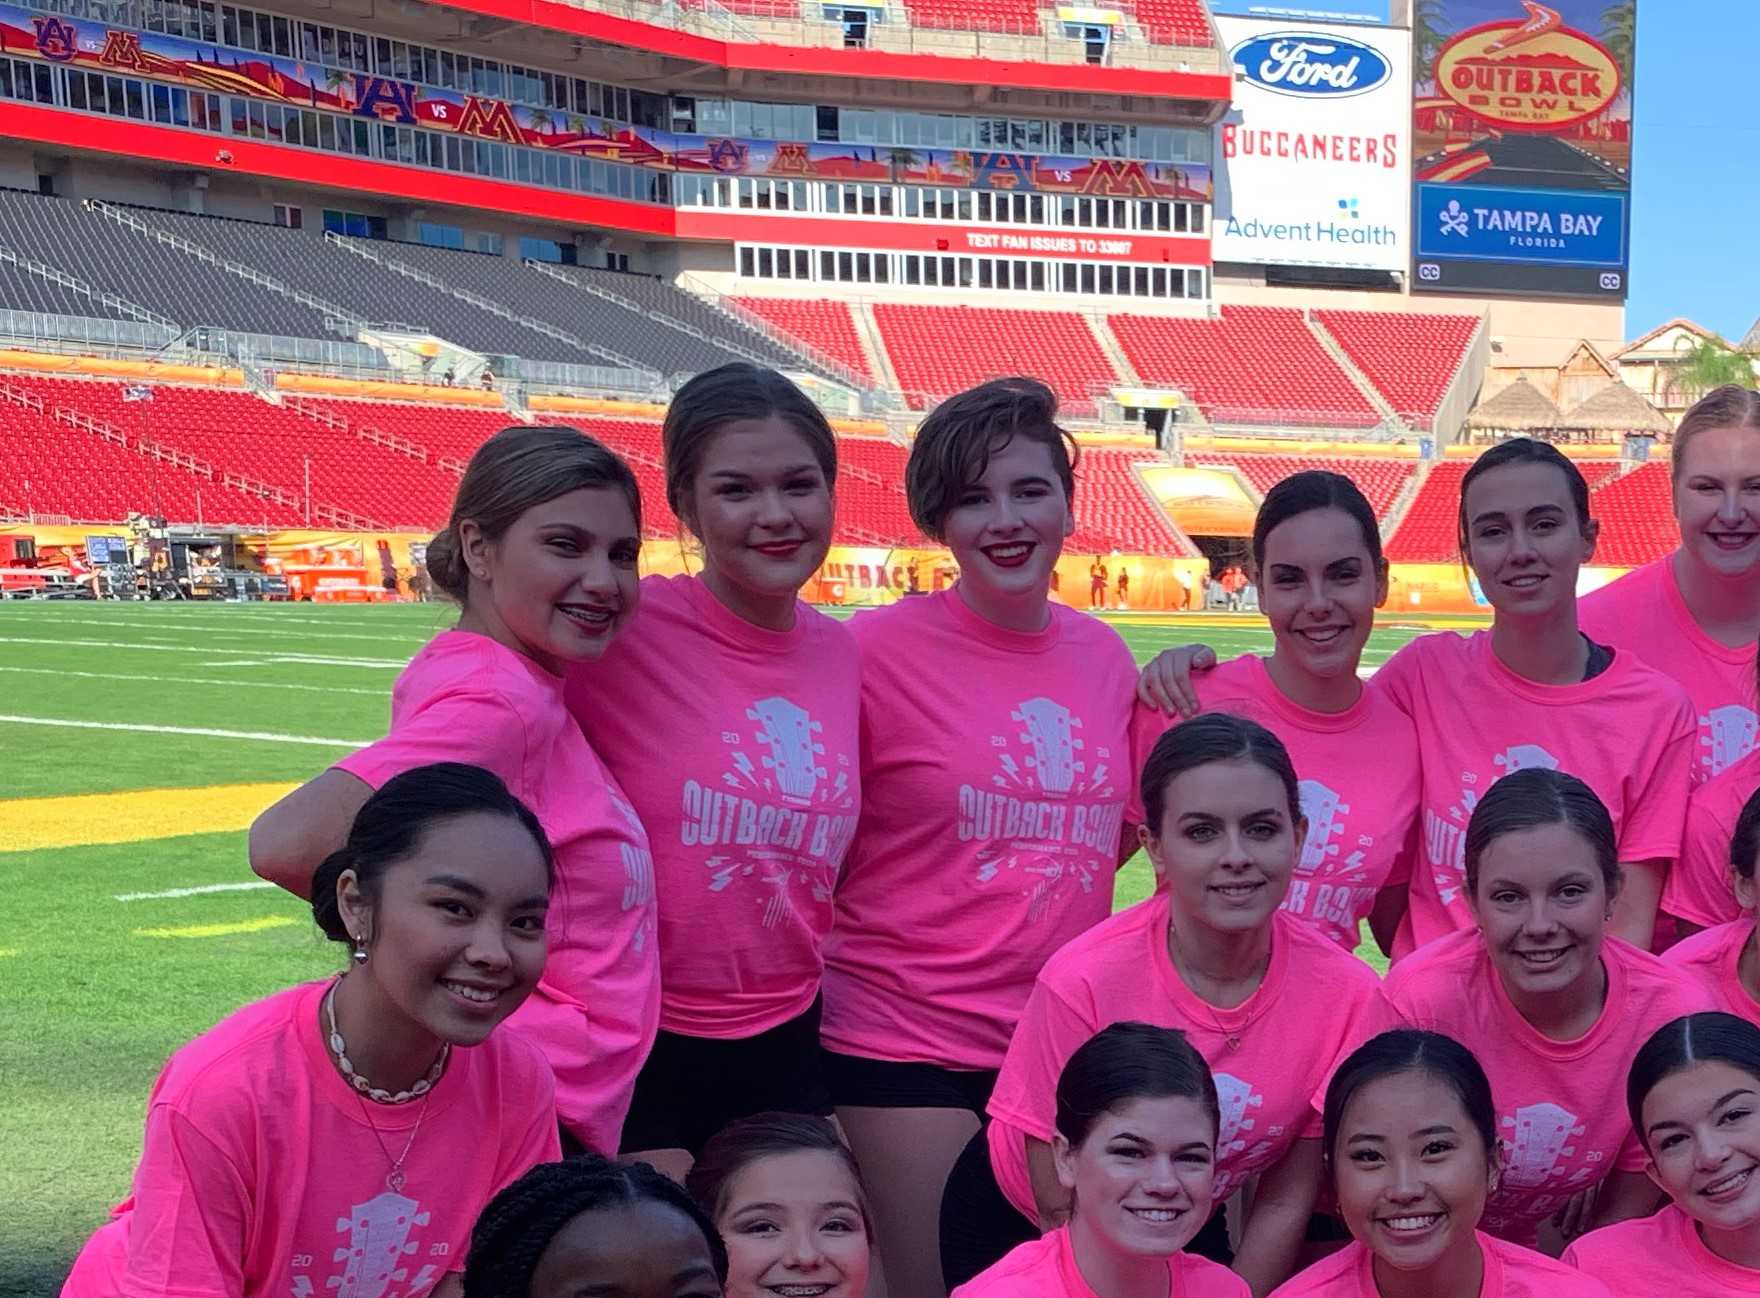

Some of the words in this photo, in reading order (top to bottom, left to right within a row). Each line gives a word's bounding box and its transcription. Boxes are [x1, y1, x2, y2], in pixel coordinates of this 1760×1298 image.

[1259, 40, 1360, 88] Ford
[1451, 66, 1600, 98] OUTBACK
[431, 104, 447, 118] VS
[1468, 94, 1586, 112] BOWL
[1221, 123, 1397, 168] BUCCANEERS
[1054, 170, 1072, 182] VS
[1474, 208, 1553, 234] TAMPA
[1560, 213, 1603, 236] BAY
[966, 233, 1001, 248] TEXT
[1002, 235, 1028, 250] FAN
[1030, 236, 1076, 253] ISSUES
[1080, 239, 1096, 253] TO
[1510, 236, 1566, 248] FLORIDA
[722, 732, 741, 745] 20
[681, 779, 808, 846] OUTBACK
[958, 783, 1067, 841] OUTBACK
[1586, 1151, 1602, 1162] 20
[430, 1242, 448, 1256] 20
[291, 1254, 313, 1267] 20
